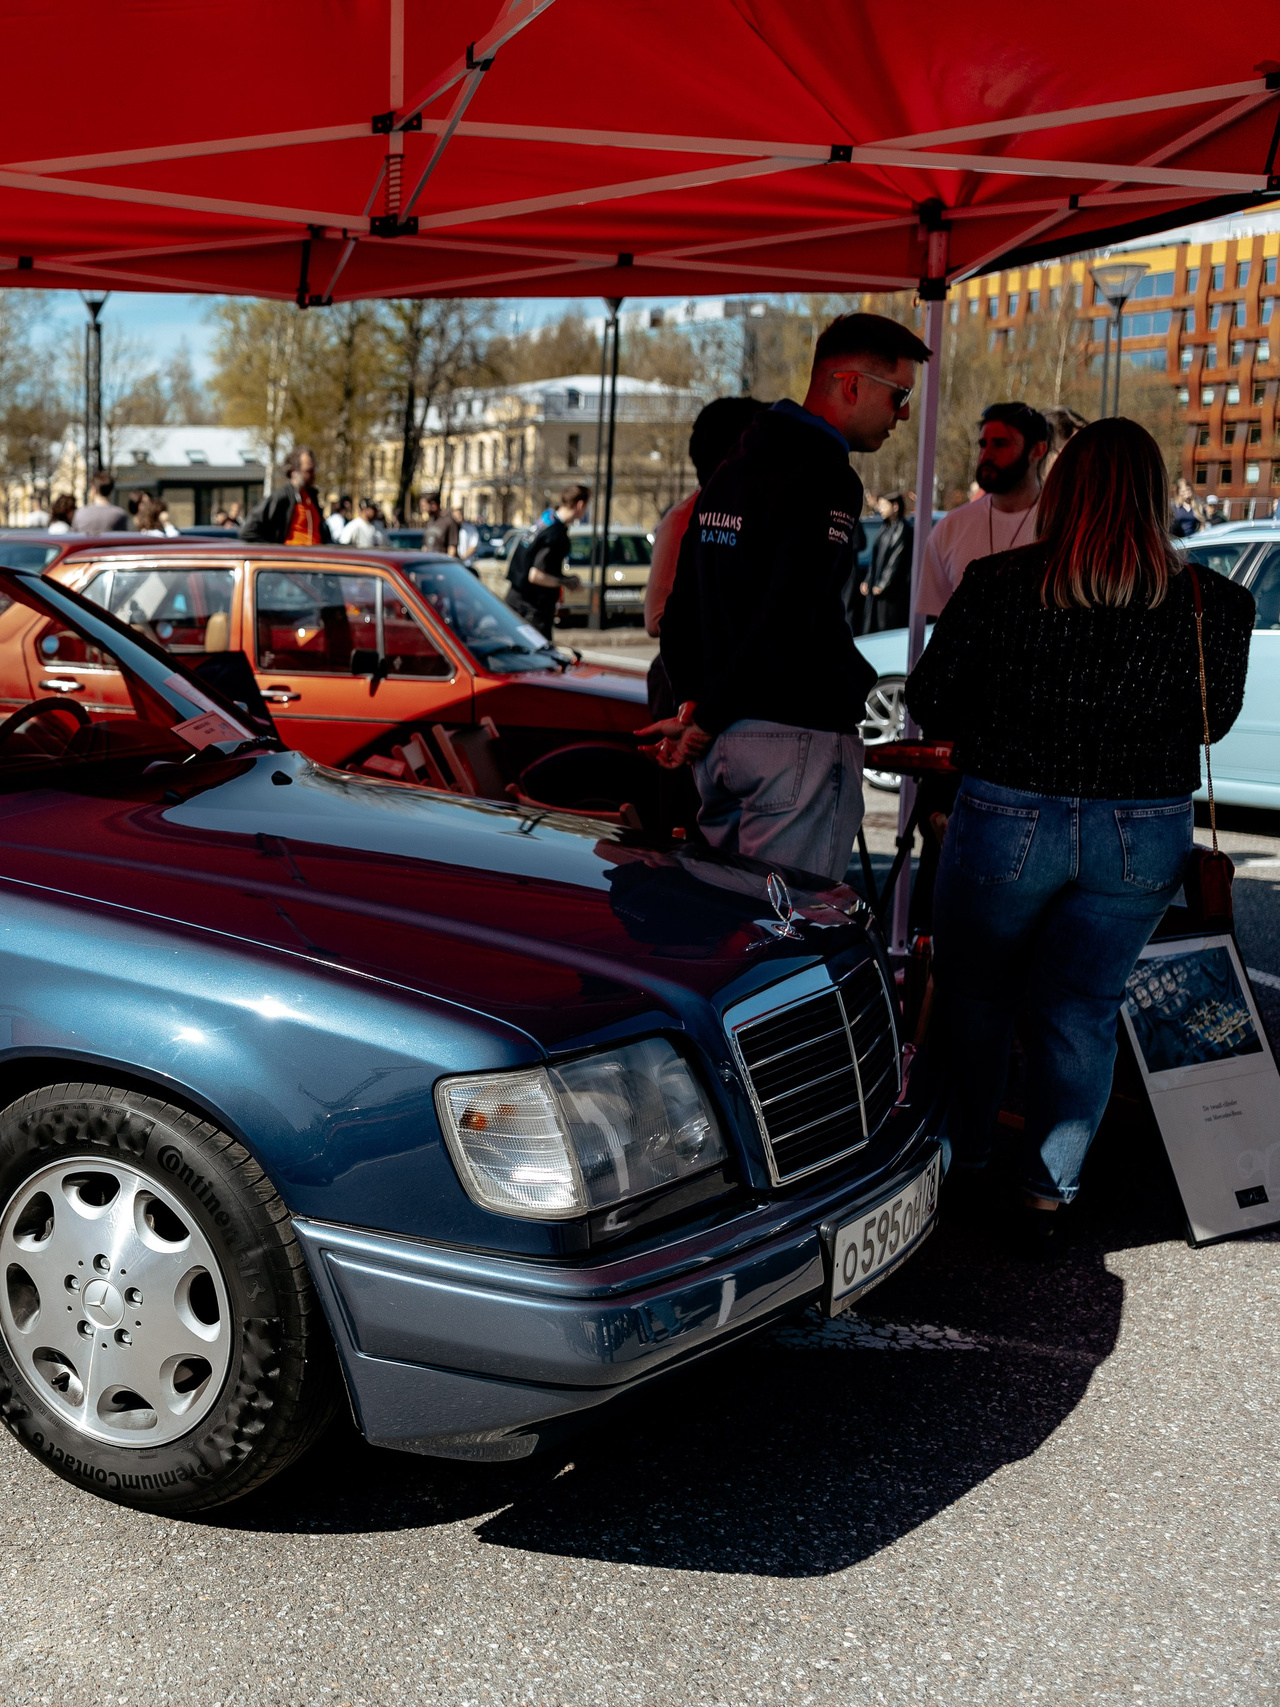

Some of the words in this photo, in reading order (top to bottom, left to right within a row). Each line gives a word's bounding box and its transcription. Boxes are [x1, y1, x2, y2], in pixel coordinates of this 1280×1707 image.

[698, 511, 743, 532] WILLIAMS
[700, 528, 737, 547] RAING
[157, 1144, 261, 1278] Continental
[45, 1441, 214, 1495] PremiumContact
